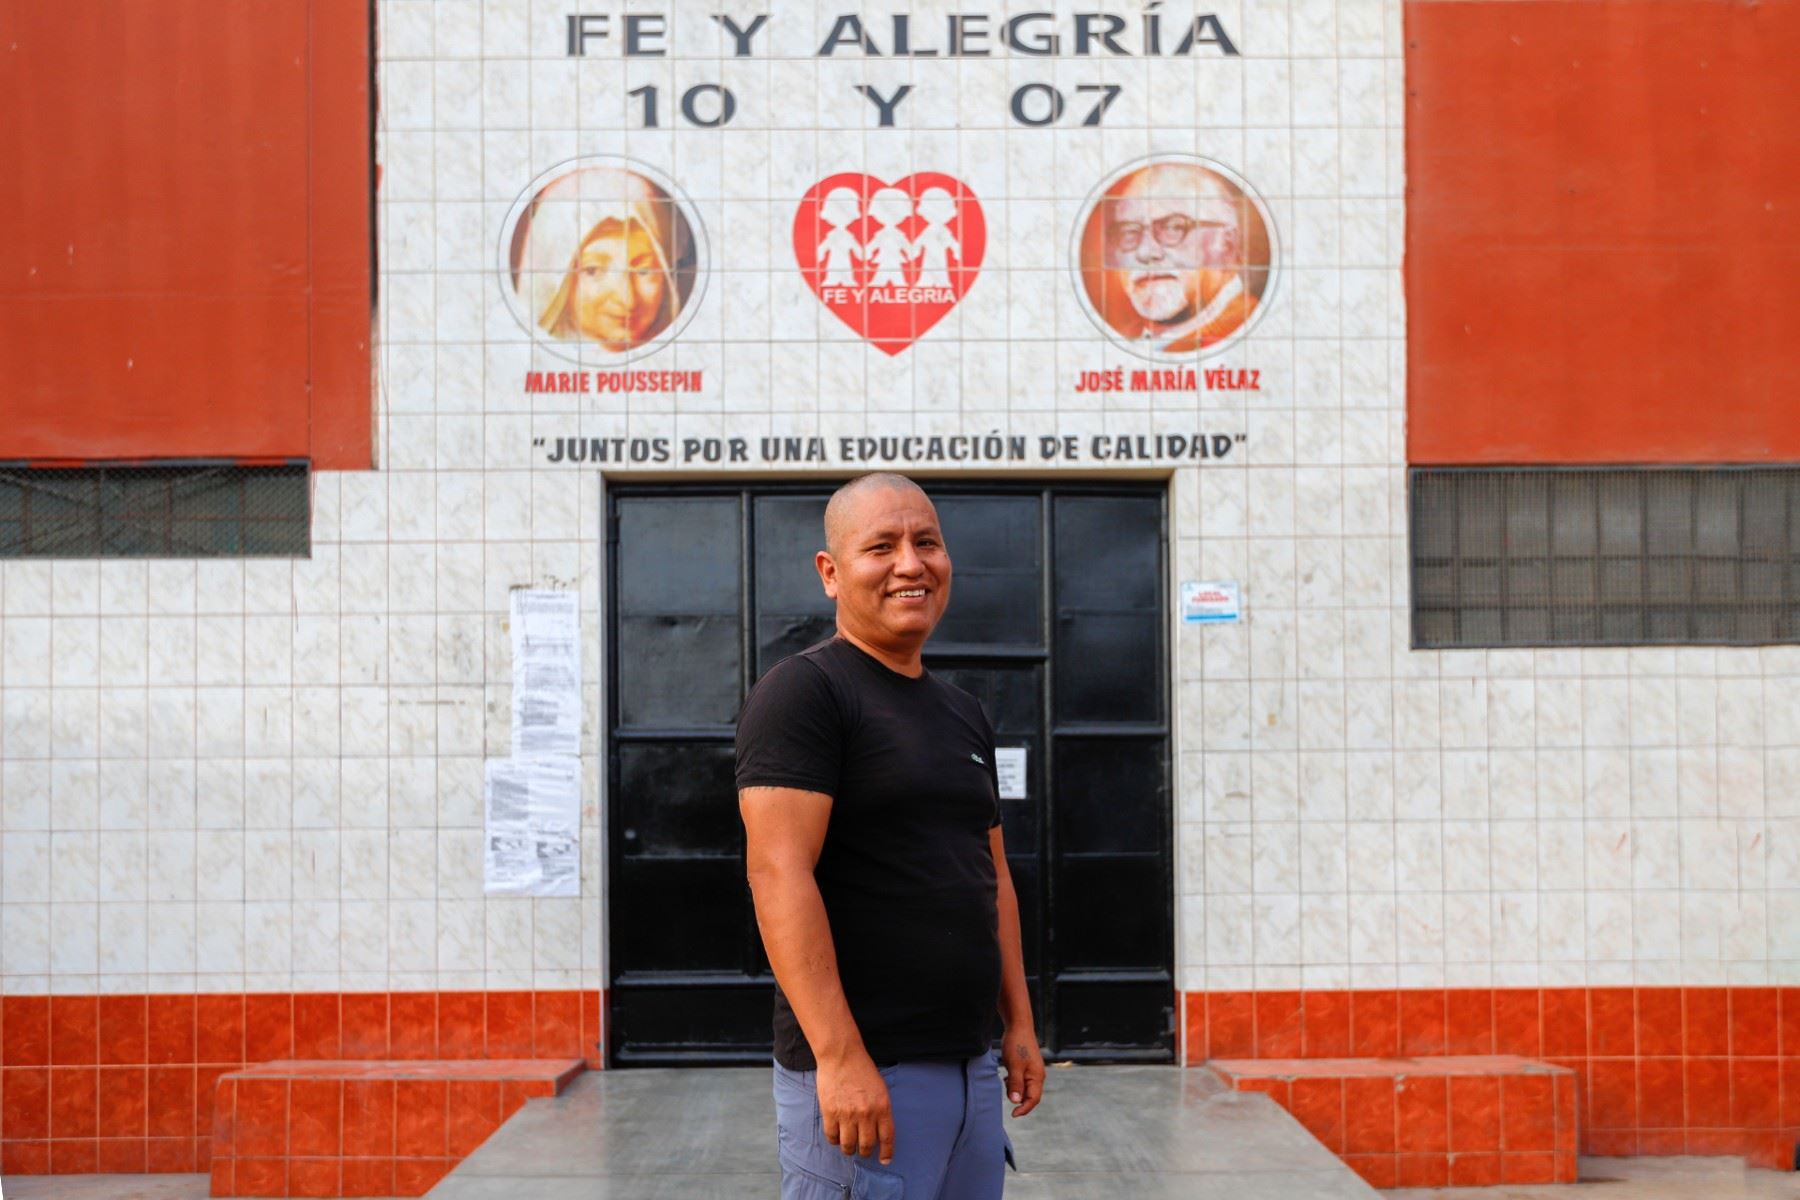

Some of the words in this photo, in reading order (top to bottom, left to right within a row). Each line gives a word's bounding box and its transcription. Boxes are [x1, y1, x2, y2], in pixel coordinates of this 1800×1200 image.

[566, 14, 666, 57] FE
[711, 14, 772, 57] Y
[817, 2, 1241, 57] ALEGRÍA
[627, 84, 737, 129] 10
[853, 84, 915, 128] Y
[1009, 83, 1122, 128] 07
[823, 288, 848, 304] FE
[851, 289, 866, 304] Y
[869, 288, 957, 304] ALEGRIA
[525, 371, 590, 393] MARIE
[596, 371, 702, 393] POUSSEPIN
[1075, 364, 1123, 393] JOSÉ
[1130, 364, 1197, 392] MARÍA
[1204, 364, 1260, 390] VÉLAZ
[683, 438, 749, 463] POR
[761, 437, 827, 462] UNA
[840, 429, 1026, 462] EDUCACIÓN
[1039, 434, 1078, 460] DE
